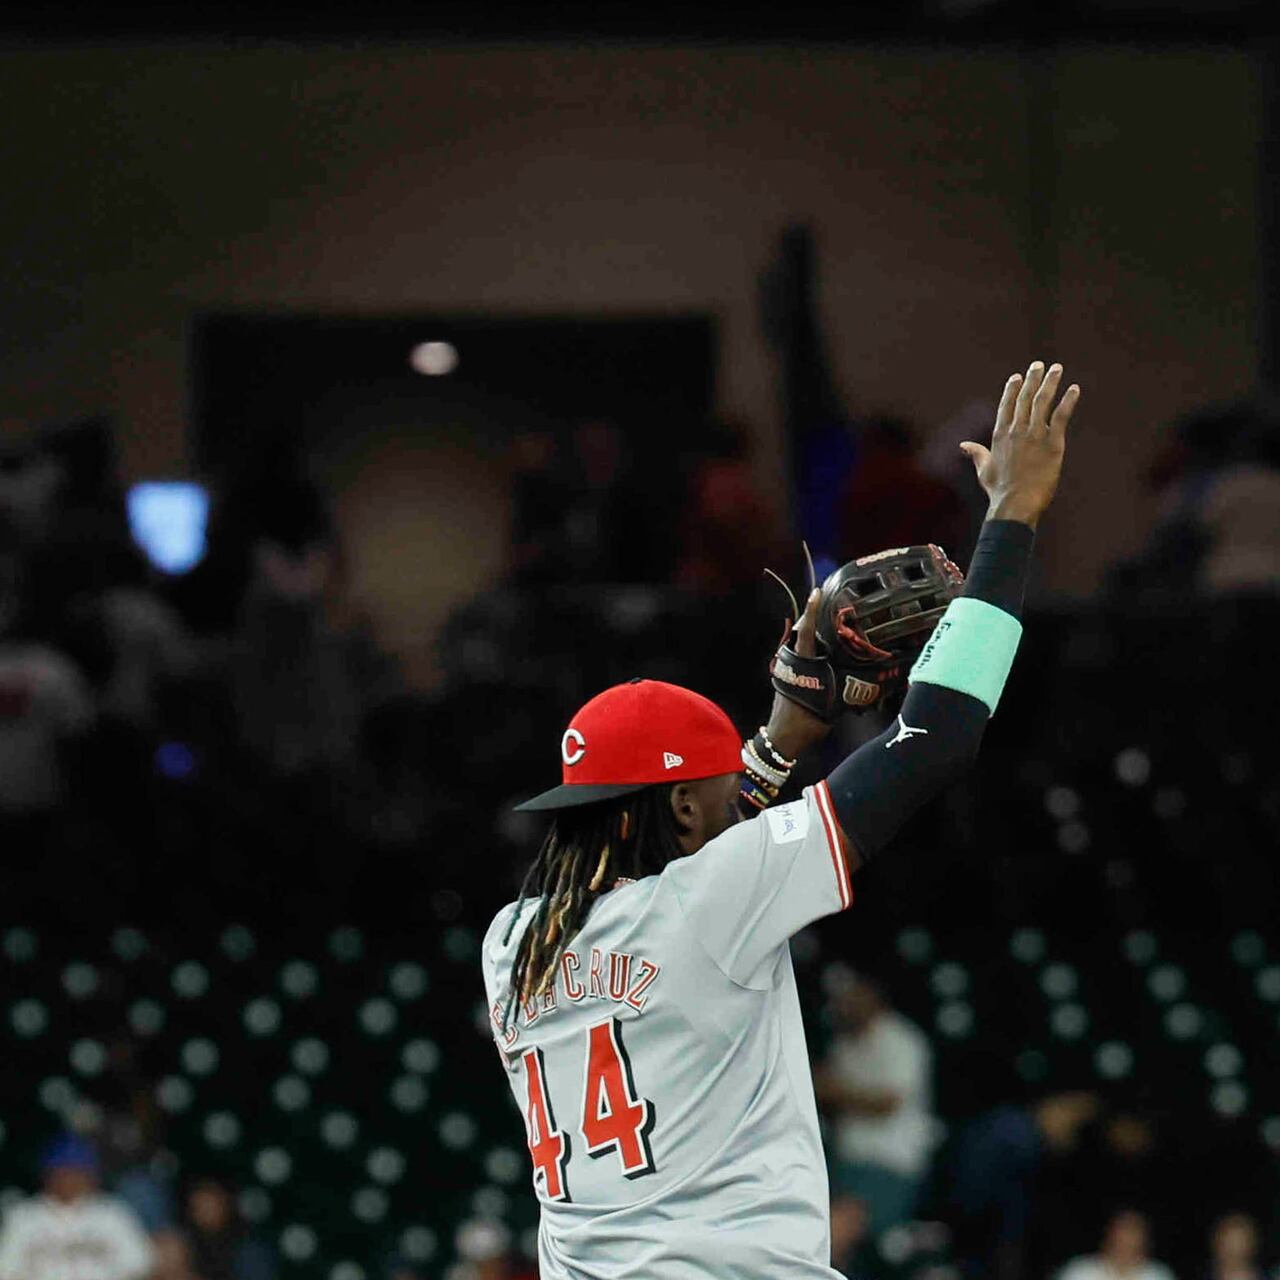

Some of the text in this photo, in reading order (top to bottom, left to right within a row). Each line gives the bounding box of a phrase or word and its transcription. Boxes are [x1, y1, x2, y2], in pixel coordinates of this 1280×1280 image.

[561, 728, 586, 766] C
[559, 947, 662, 1017] CRUZ
[522, 1017, 657, 1203] 44
